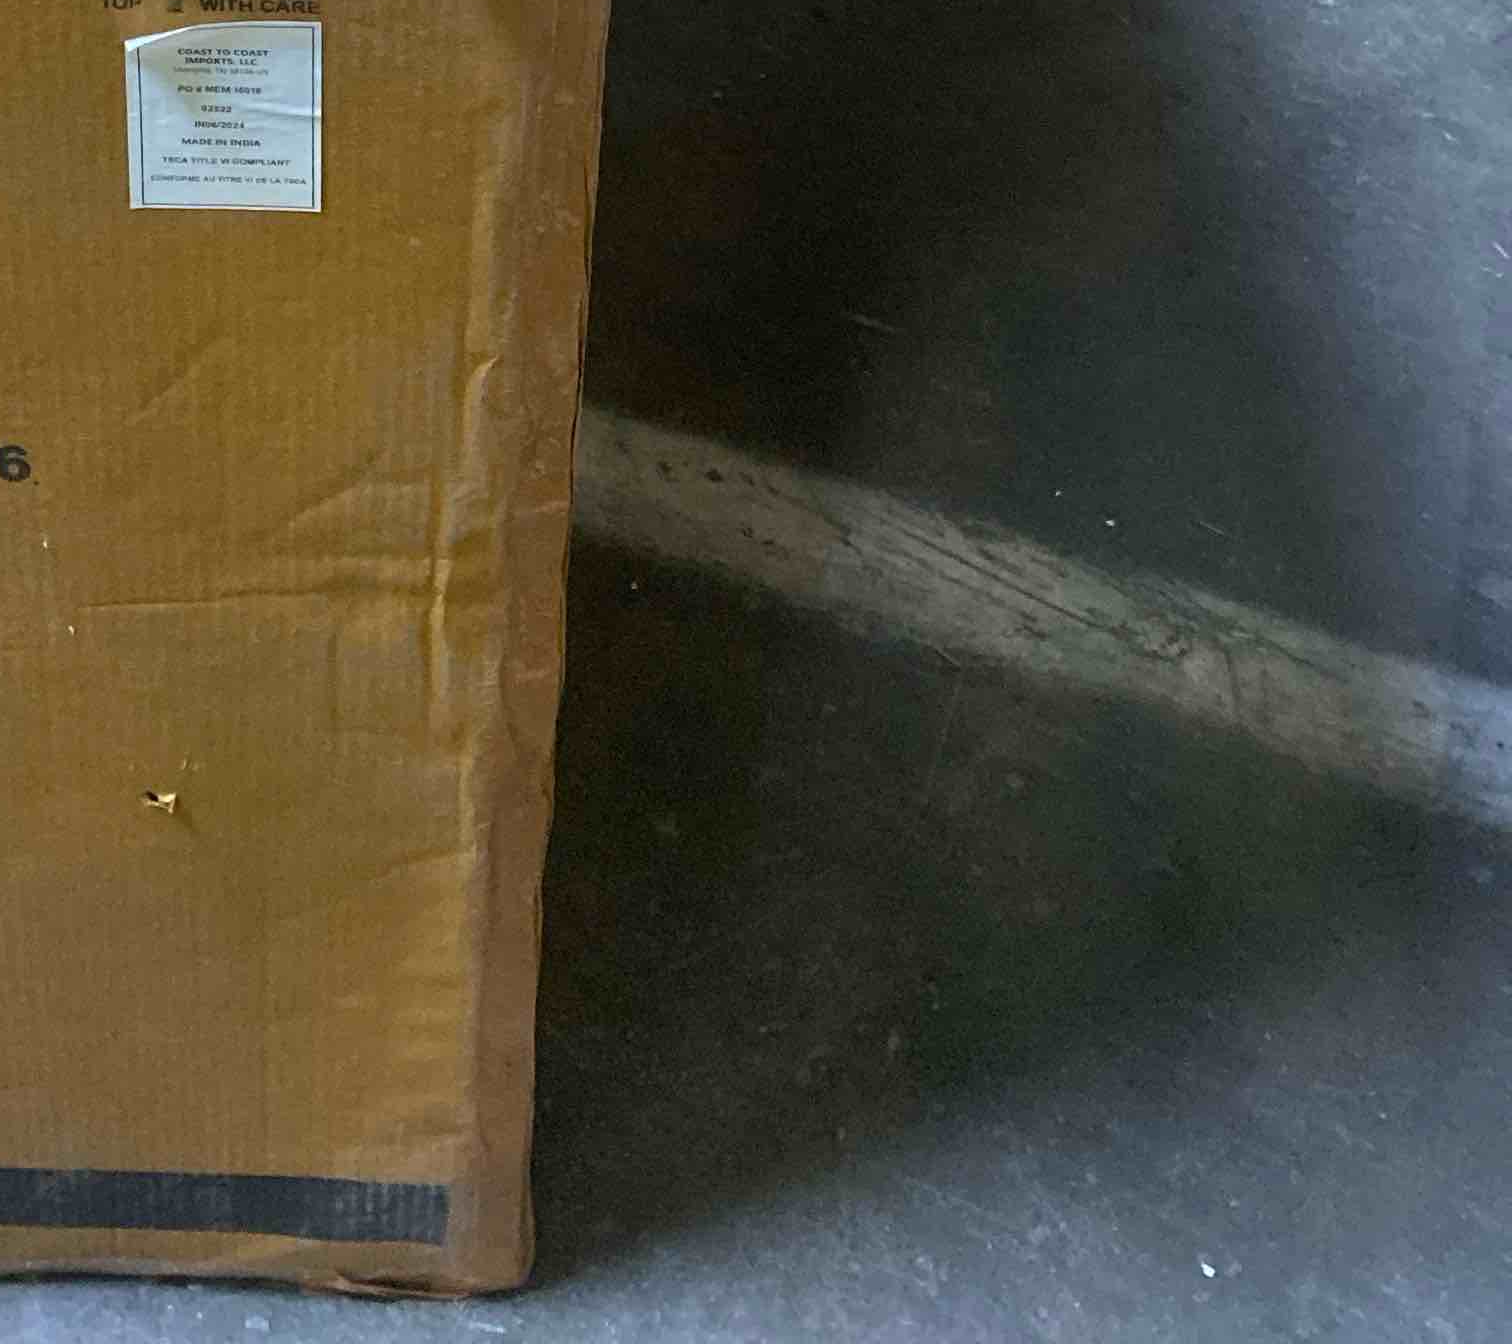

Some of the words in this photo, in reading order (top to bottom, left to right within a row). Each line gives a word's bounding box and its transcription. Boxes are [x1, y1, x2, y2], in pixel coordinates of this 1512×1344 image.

[259, 0, 320, 14] CARE
[177, 47, 213, 56] COAST
[216, 48, 232, 56] TO
[234, 49, 271, 57] COAST
[181, 137, 213, 146] MADE
[230, 138, 262, 147] INDIA
